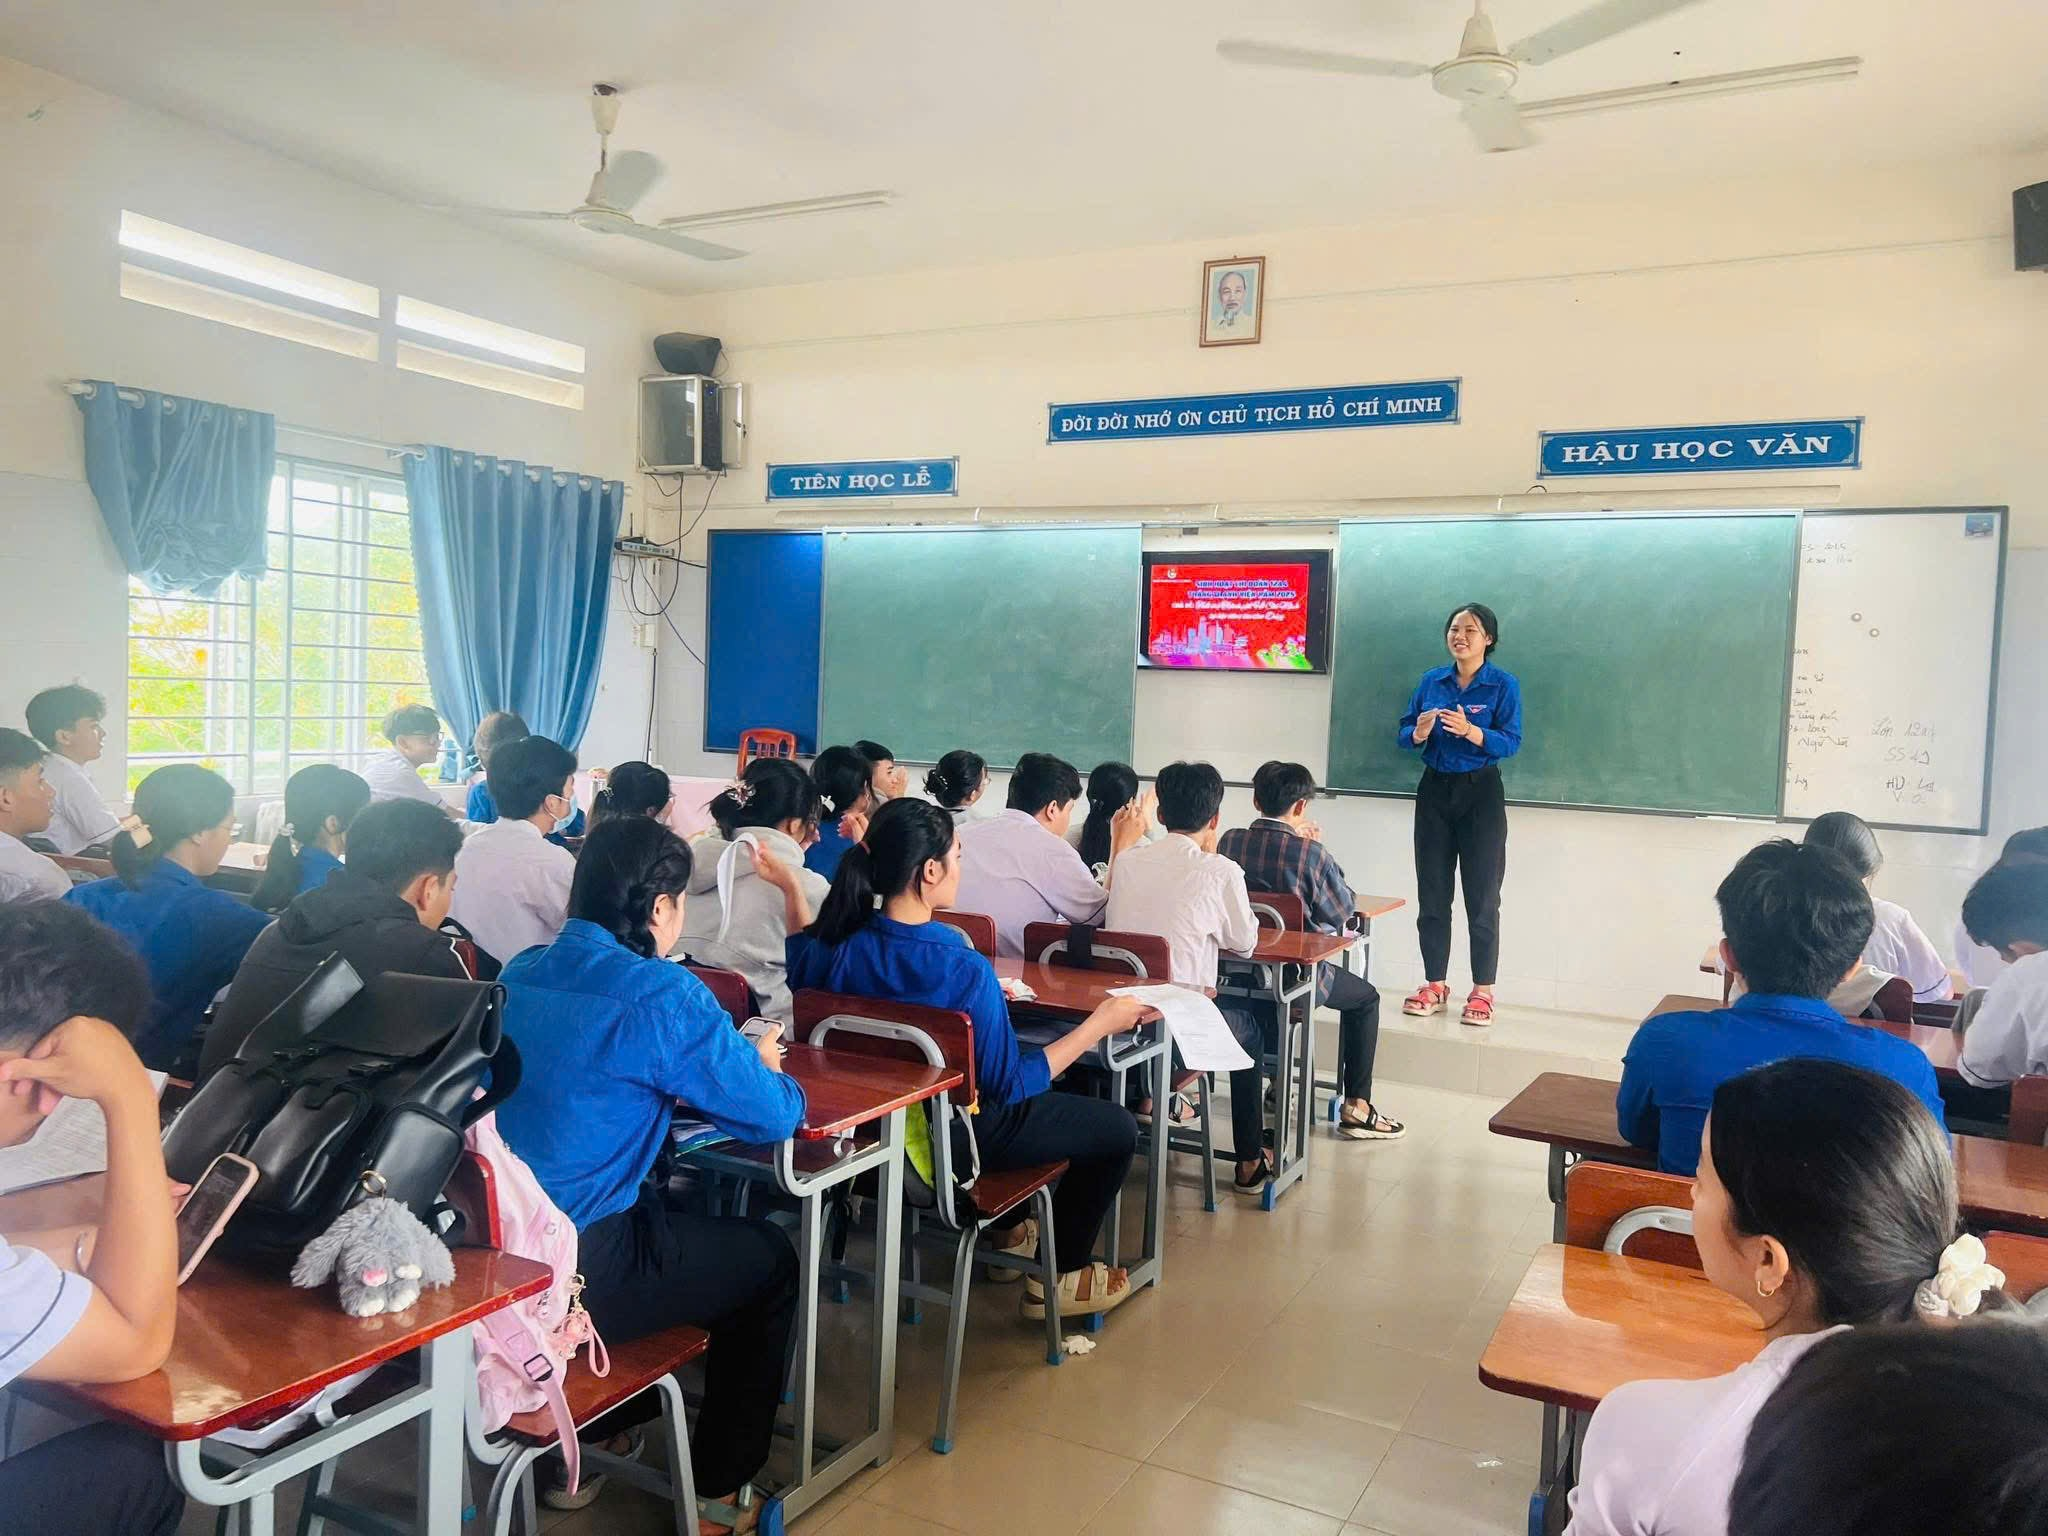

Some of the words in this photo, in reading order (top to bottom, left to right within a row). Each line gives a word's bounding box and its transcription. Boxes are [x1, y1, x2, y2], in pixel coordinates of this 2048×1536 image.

[1062, 413, 1092, 432] ĐỜI
[1097, 412, 1128, 431] ĐỜI
[1134, 410, 1172, 429] NHỚ
[1178, 410, 1203, 426] ƠN
[1208, 404, 1247, 425] CHỦ
[1254, 405, 1302, 425] TỊCH
[1307, 396, 1336, 419] HỒ
[1343, 397, 1379, 417] CHÍ
[1386, 397, 1442, 415] MINH
[1562, 441, 1640, 465] HẬU
[1652, 440, 1733, 463] HỌC
[1747, 432, 1832, 456] VĂN
[790, 473, 842, 490] TIÊN
[848, 473, 895, 491] HỌC
[902, 466, 932, 487] LỄ
